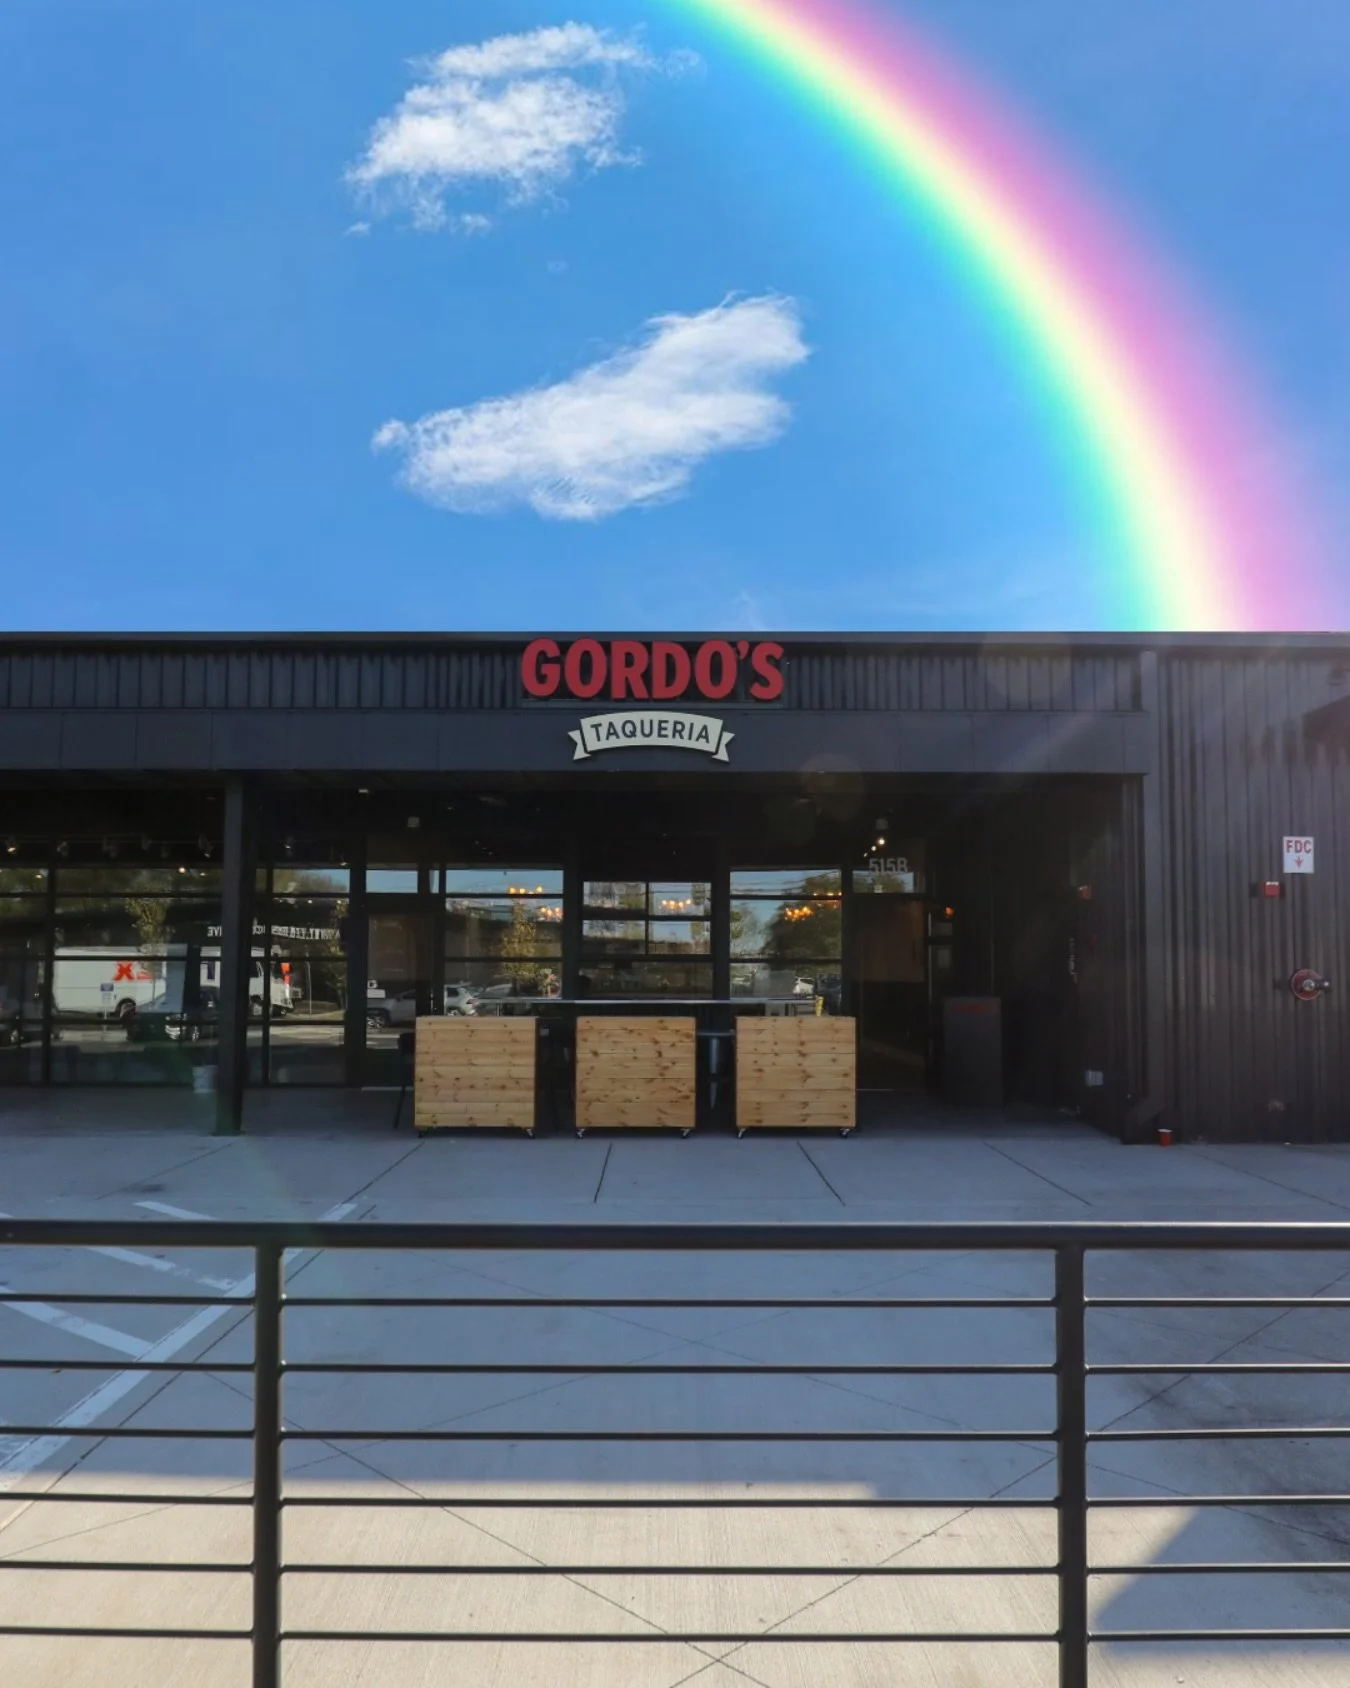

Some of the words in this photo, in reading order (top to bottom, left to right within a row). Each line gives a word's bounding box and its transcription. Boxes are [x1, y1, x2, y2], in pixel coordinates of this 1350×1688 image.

[521, 638, 784, 700] GORDO'S
[590, 719, 710, 744] TAQUERIA
[1286, 839, 1312, 854] FDC
